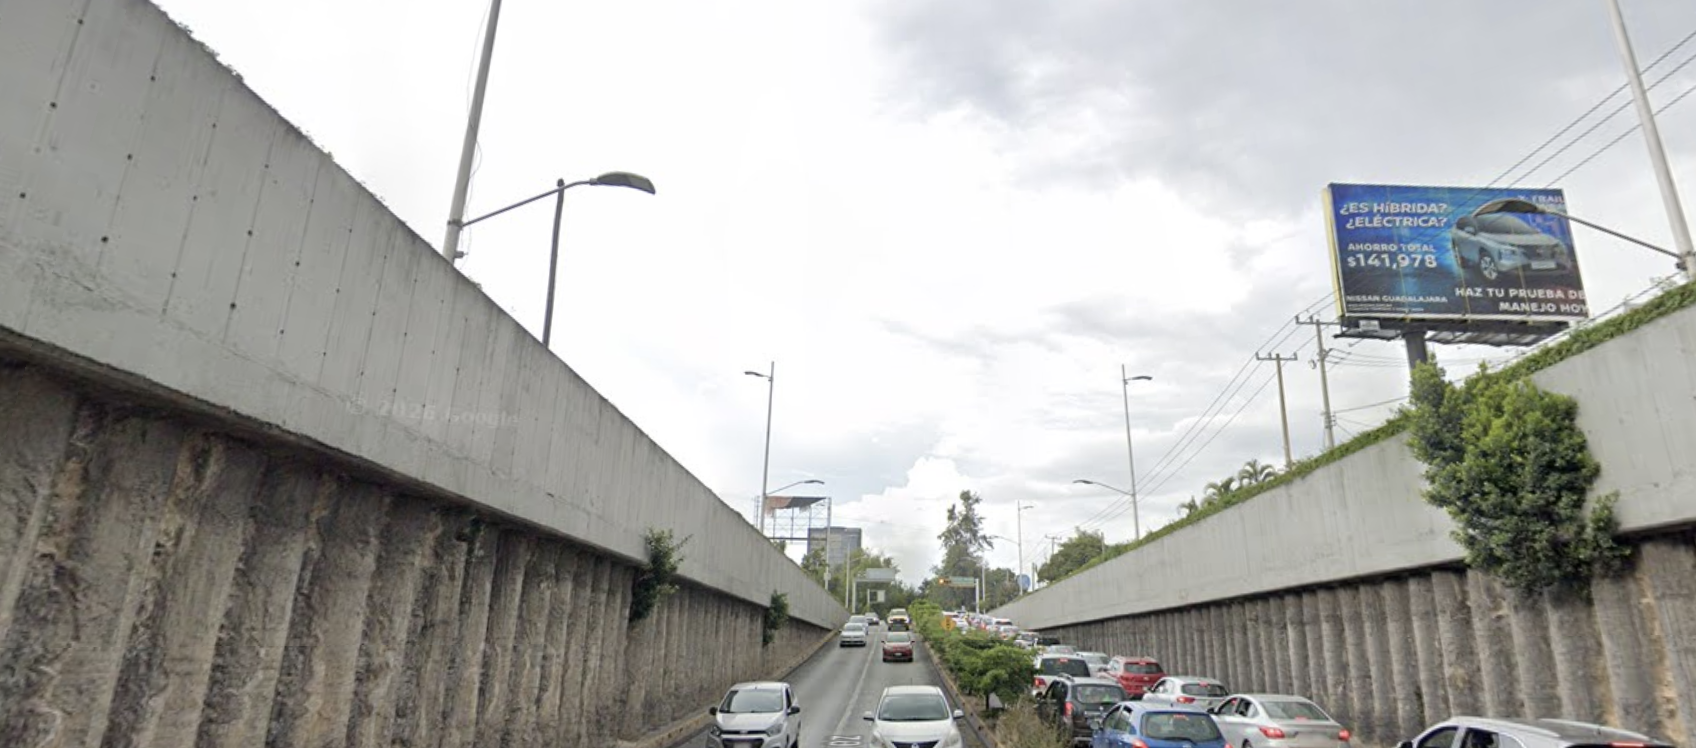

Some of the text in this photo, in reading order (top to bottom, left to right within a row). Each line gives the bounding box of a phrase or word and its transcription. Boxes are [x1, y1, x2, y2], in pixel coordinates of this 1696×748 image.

[1339, 202, 1369, 216] ¿ES
[1345, 214, 1448, 229] ¿ELÉCTRICA?
[1347, 243, 1437, 252] AHORRO TOTAL
[1347, 253, 1437, 269] $141,978
[1381, 295, 1448, 303] GUADALAJARA
[1455, 287, 1586, 299] HAZ TU PRUEBA DE
[1499, 301, 1590, 313] MANEJO HOY
